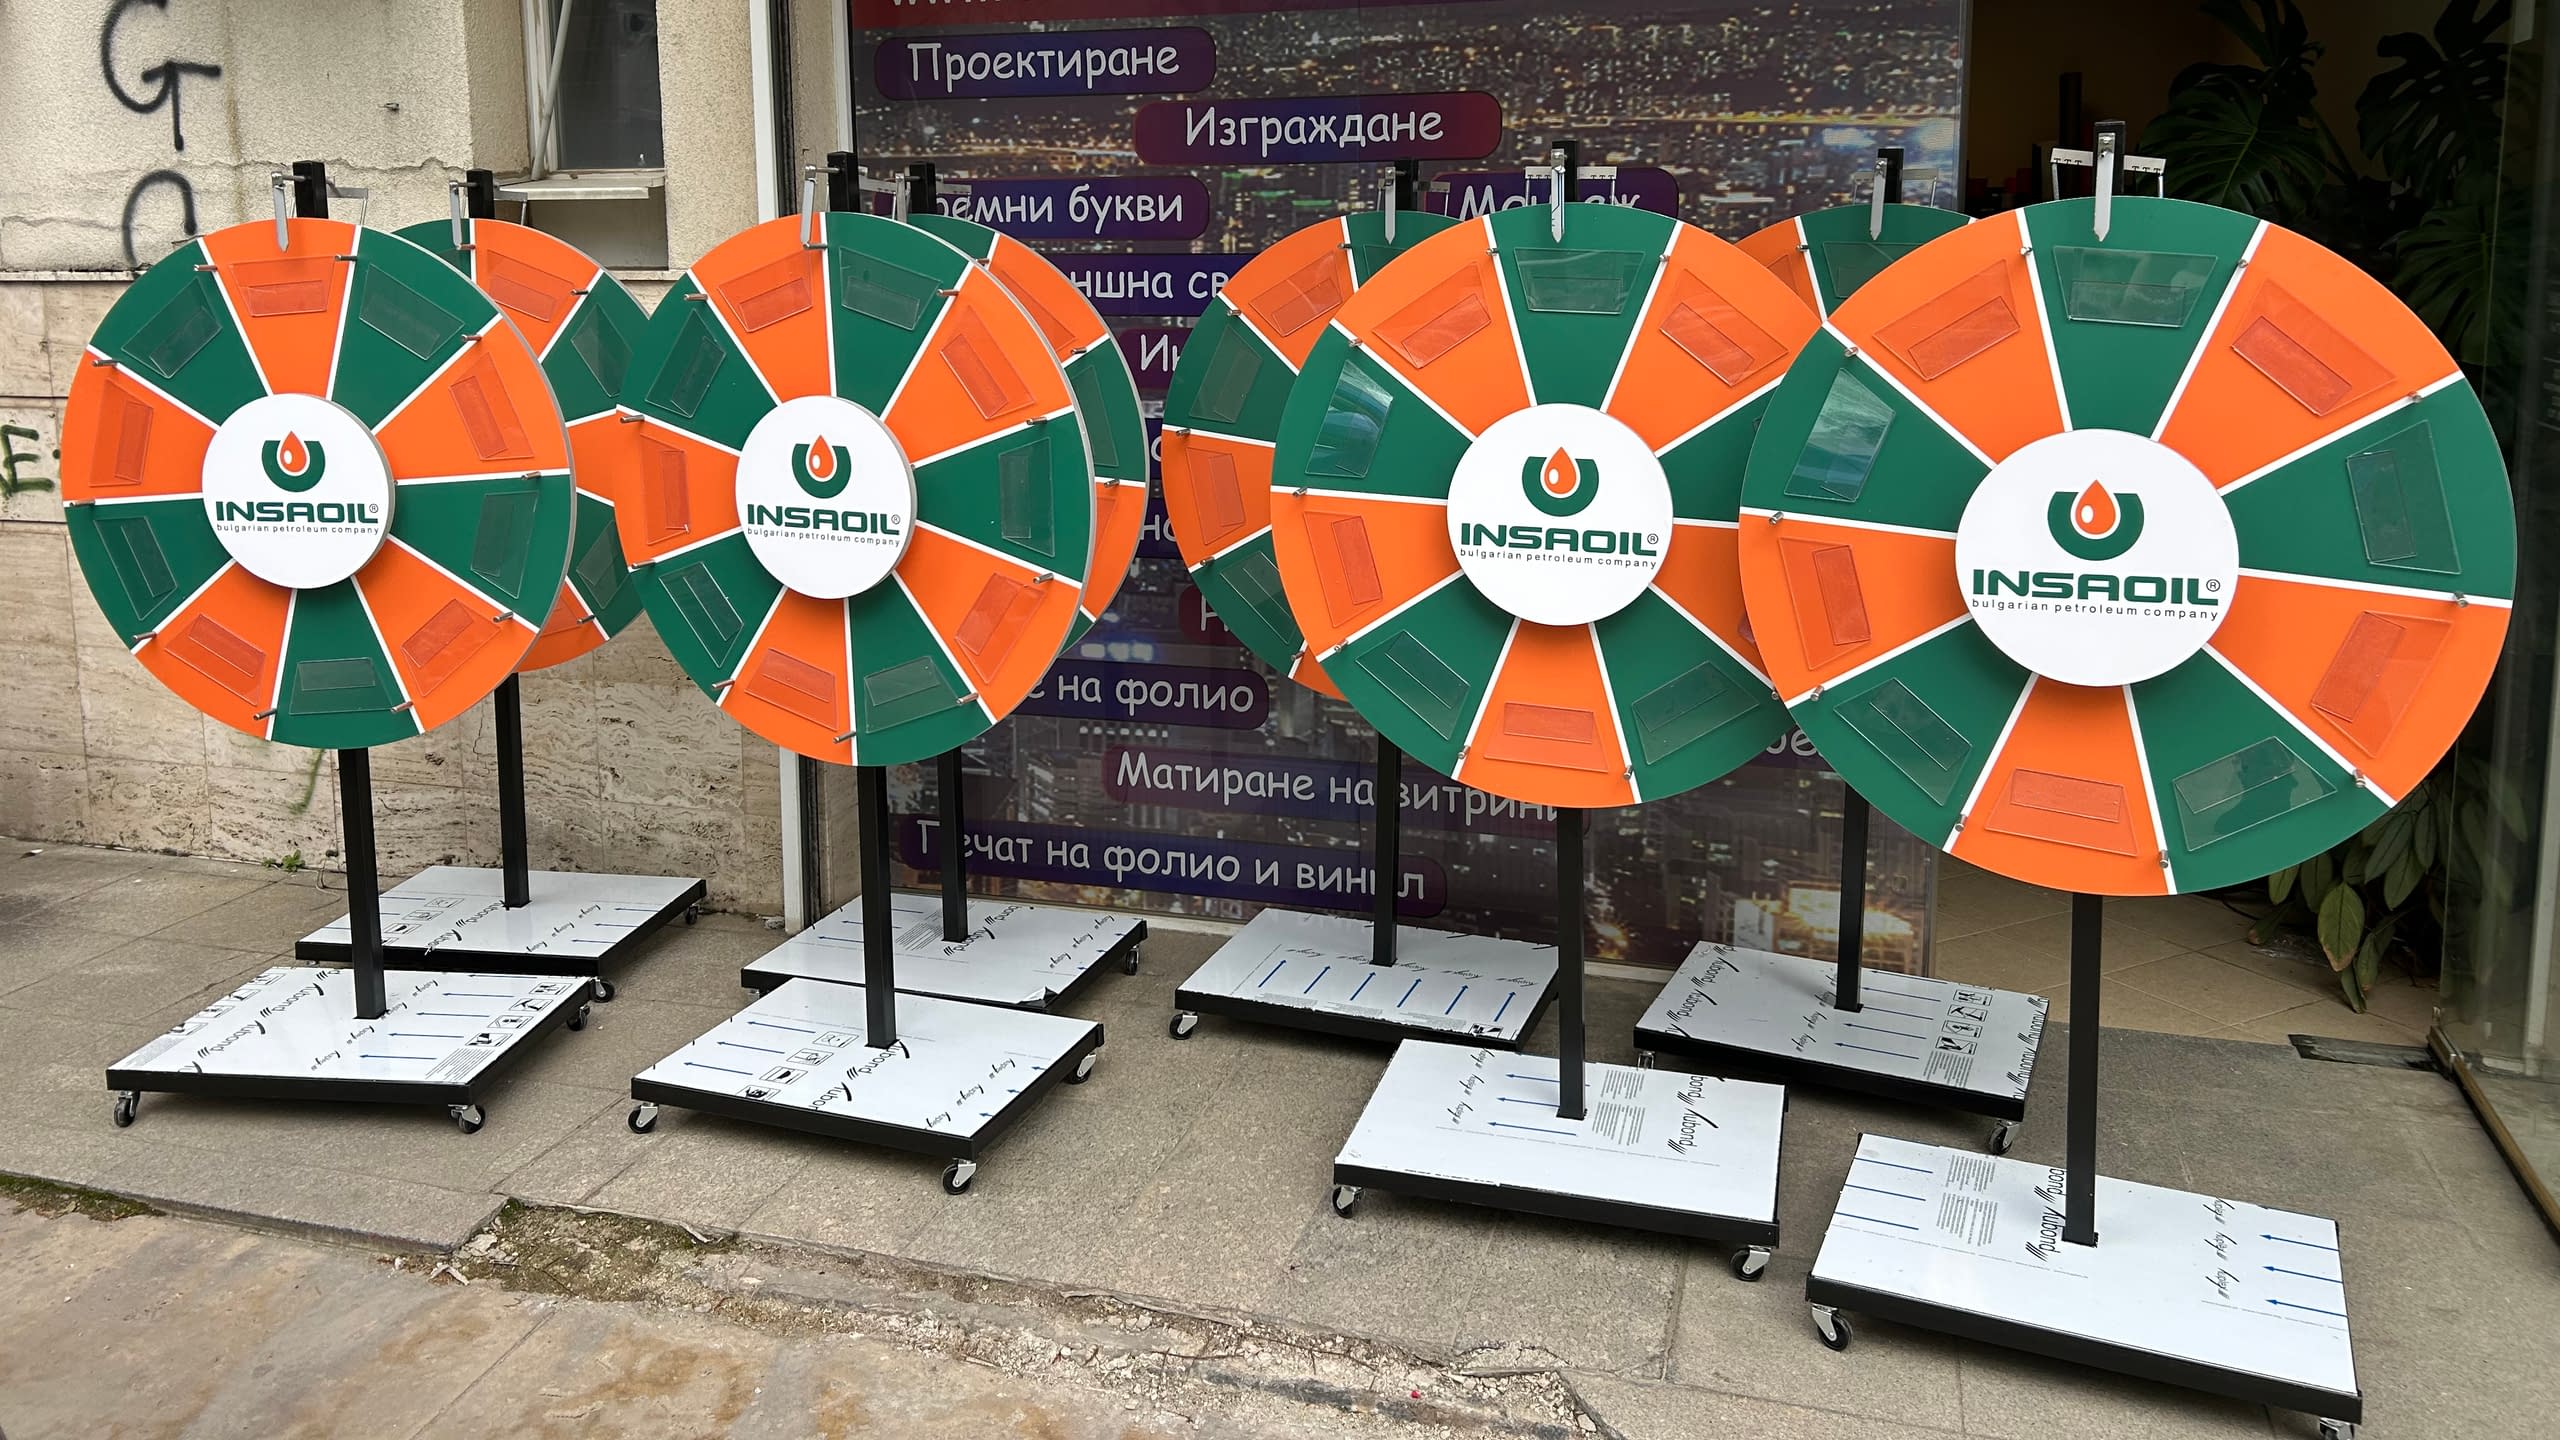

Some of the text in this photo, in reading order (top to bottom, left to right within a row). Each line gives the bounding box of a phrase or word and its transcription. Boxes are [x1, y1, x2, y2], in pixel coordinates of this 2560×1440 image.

[907, 43, 1180, 93] Проектиране
[1186, 106, 1443, 157] Изграждане
[937, 184, 1183, 234] емни букви
[216, 524, 379, 535] bulgarian petroleum company
[747, 528, 900, 547] bulgarian petroleum company
[1460, 549, 1657, 570] bulgarian petroleum company
[1972, 599, 2219, 621] bulgarian petroleum company
[1058, 675, 1102, 703] на
[1115, 678, 1254, 717] фолио
[1116, 751, 1557, 826] Матиране на витрин
[1047, 840, 1090, 869] на
[1103, 846, 1241, 883] фолио
[1254, 858, 1280, 887] и
